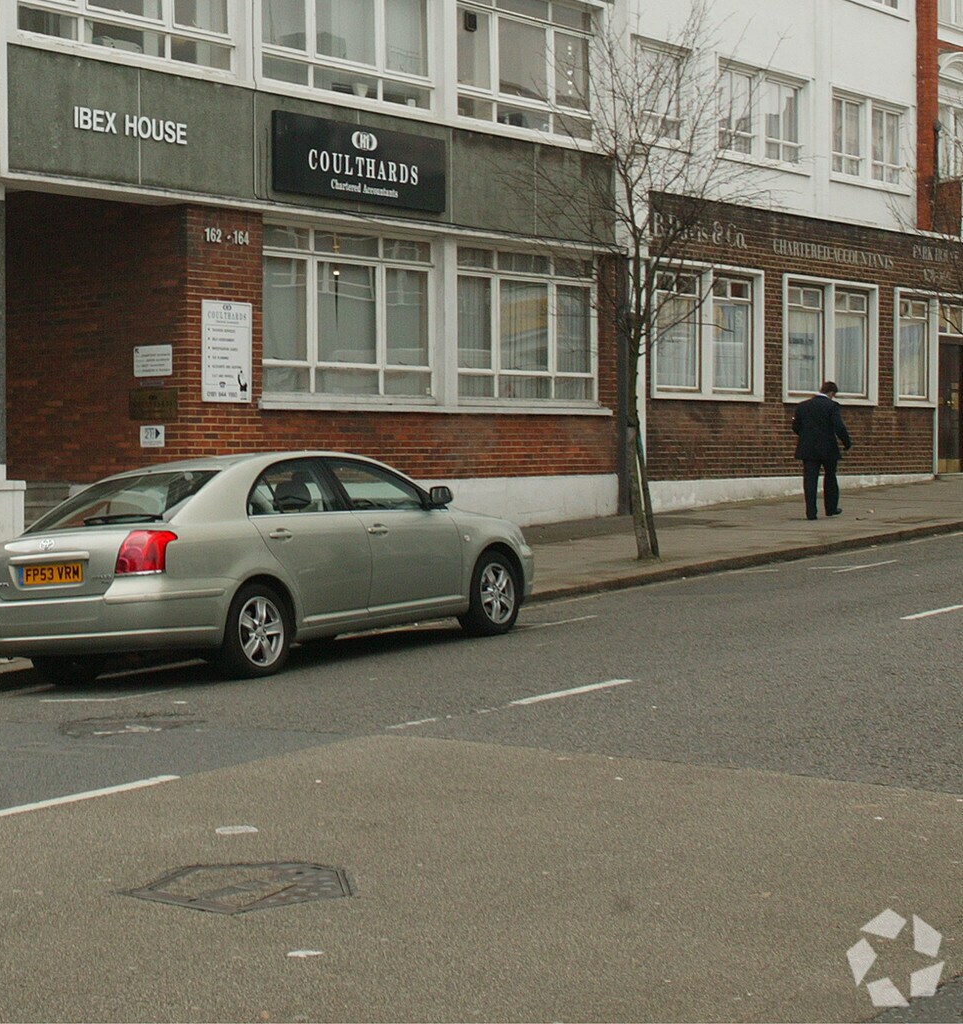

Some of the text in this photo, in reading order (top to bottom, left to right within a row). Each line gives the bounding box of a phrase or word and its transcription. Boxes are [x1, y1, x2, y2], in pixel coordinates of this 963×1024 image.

[74, 106, 188, 145] IBEX HOUSE
[308, 148, 419, 186] COULTHARDS
[330, 178, 399, 199] Chartered Accountants
[204, 227, 222, 243] 162
[232, 230, 250, 246] 164
[712, 220, 723, 245] &
[773, 238, 895, 270] CHARTERED ACCOUNTANTS
[207, 310, 247, 321] COULTHARDS
[25, 567, 54, 582] FP53
[57, 565, 80, 580] VRM
